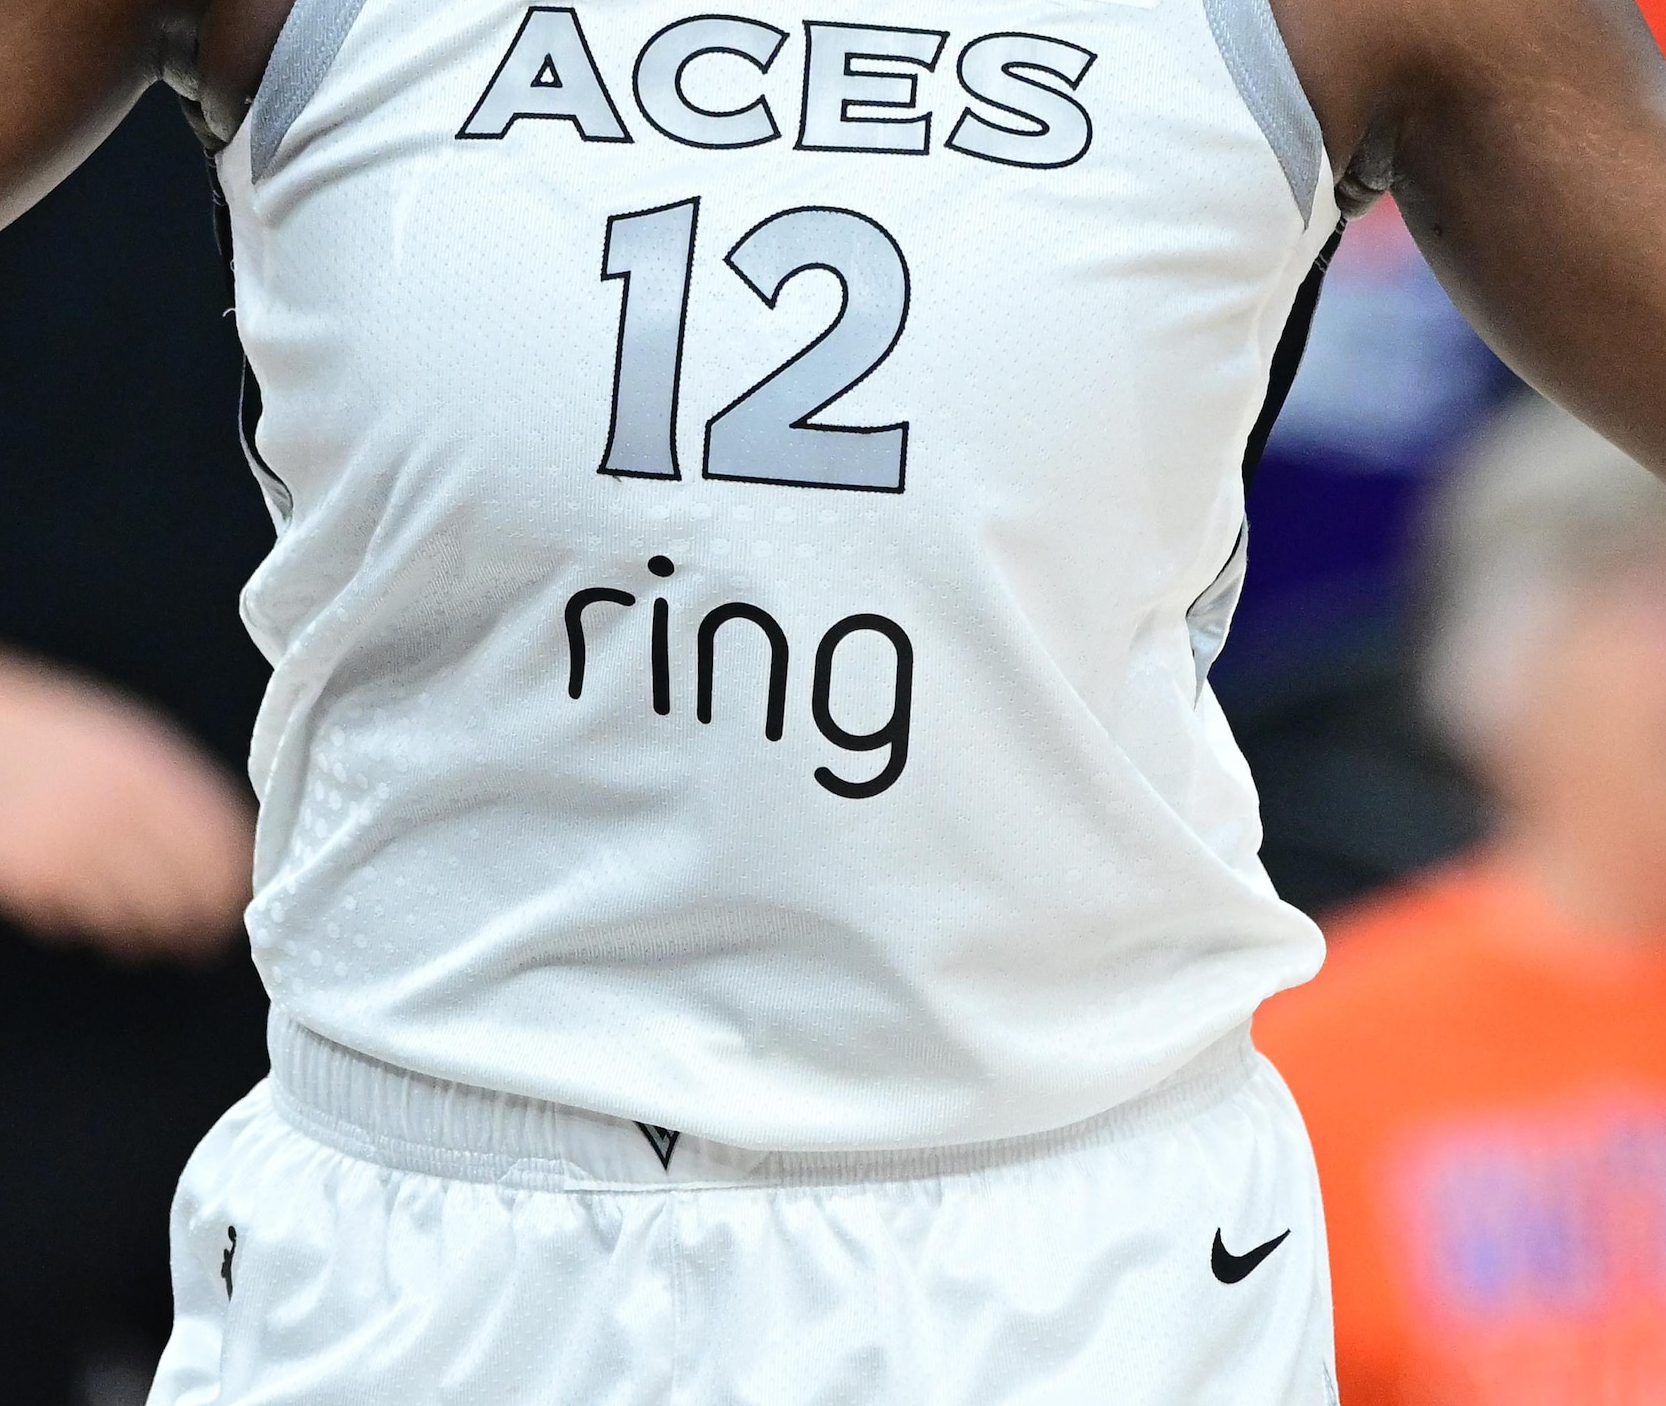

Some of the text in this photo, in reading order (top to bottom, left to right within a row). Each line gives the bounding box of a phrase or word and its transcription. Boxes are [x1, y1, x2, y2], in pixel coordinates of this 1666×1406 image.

[455, 5, 1098, 170] ACES
[596, 195, 912, 495] 12
[564, 555, 914, 800] ring
